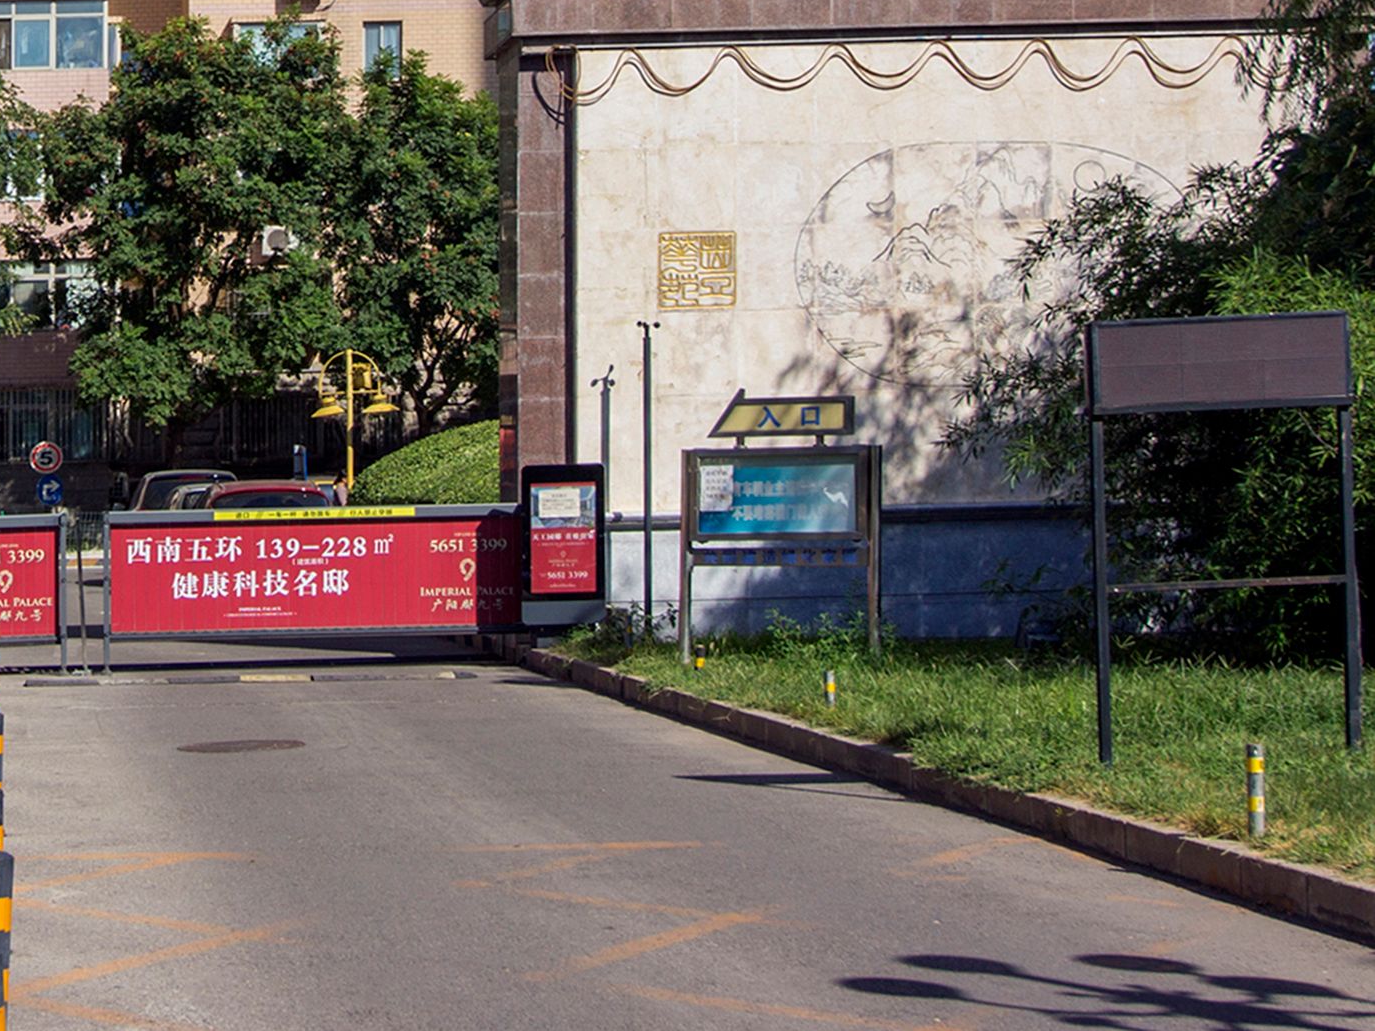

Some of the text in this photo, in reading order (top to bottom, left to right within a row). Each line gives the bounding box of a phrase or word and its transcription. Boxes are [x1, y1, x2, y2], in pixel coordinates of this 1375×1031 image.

[757, 406, 822, 429] 入口
[40, 450, 53, 466] 5
[126, 536, 243, 565] 西南五环
[429, 538, 508, 553] 5651 3399
[7, 549, 45, 565] 3399
[172, 569, 350, 600] 健康科技名邸
